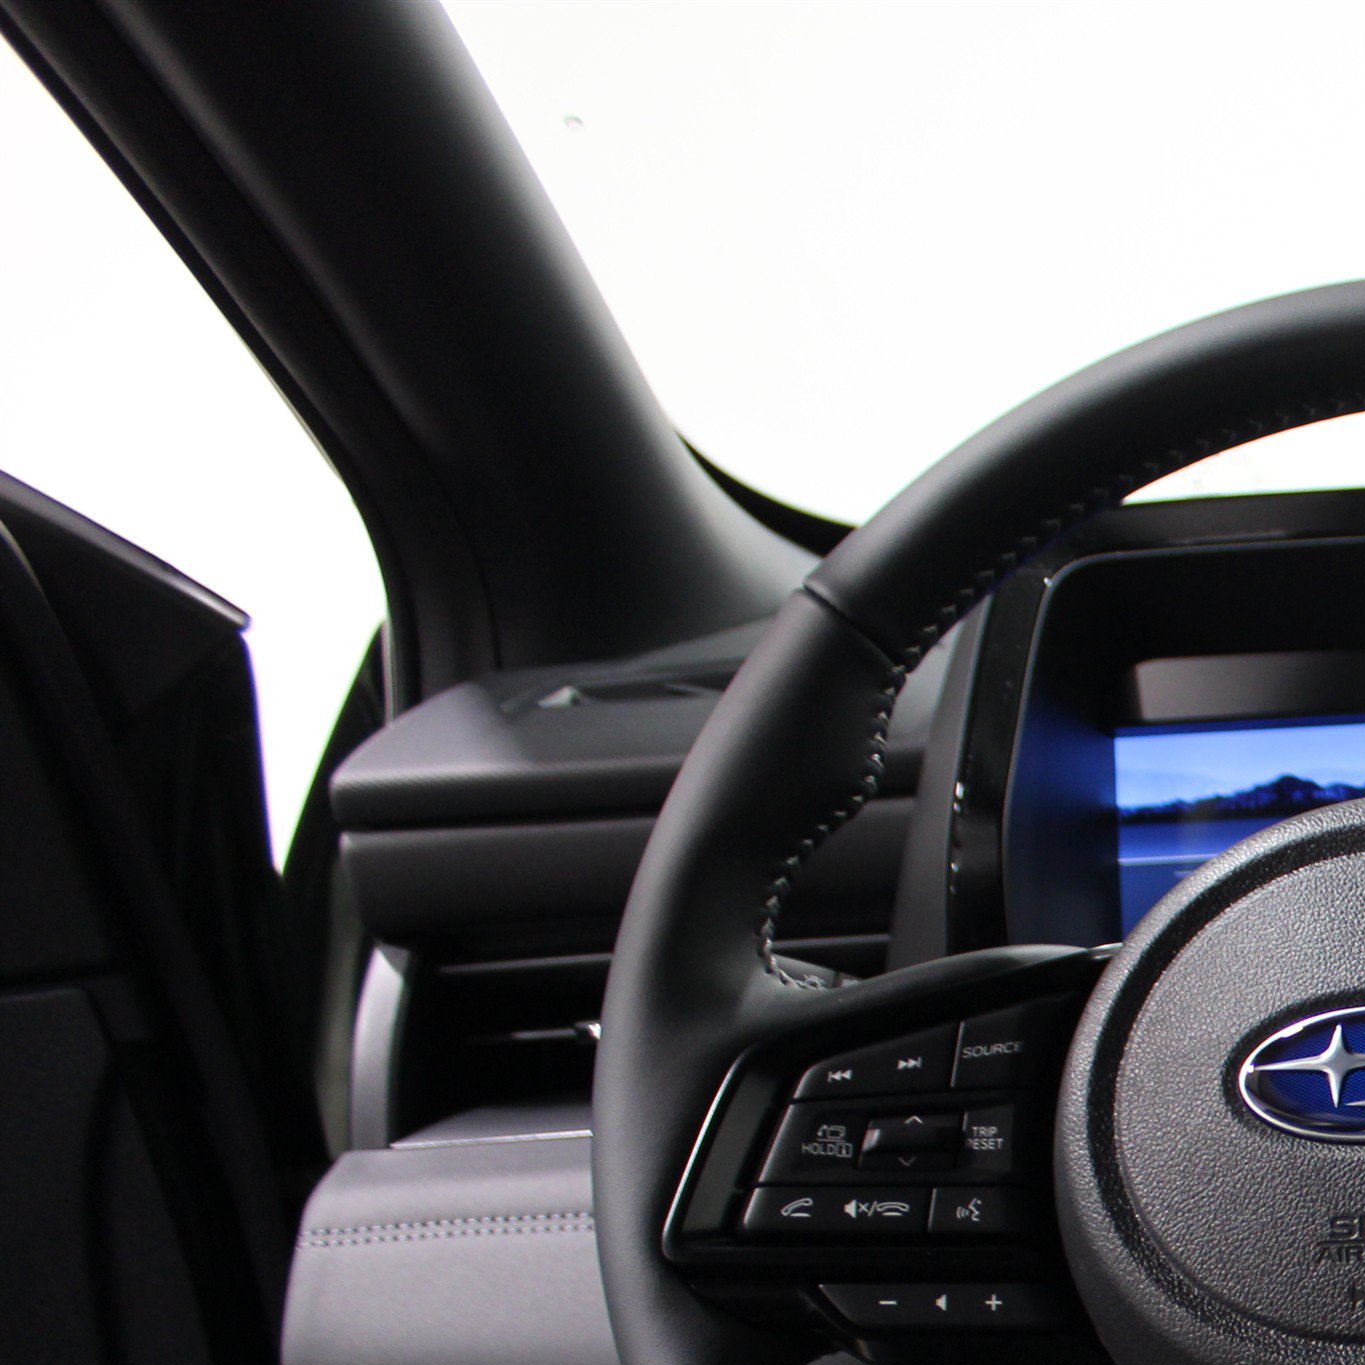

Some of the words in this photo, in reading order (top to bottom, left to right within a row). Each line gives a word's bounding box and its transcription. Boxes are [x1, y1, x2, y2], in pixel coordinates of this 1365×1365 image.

[962, 1041, 1024, 1059] SOURCE
[971, 1126, 998, 1138] TRIP
[801, 1142, 836, 1157] HOLD
